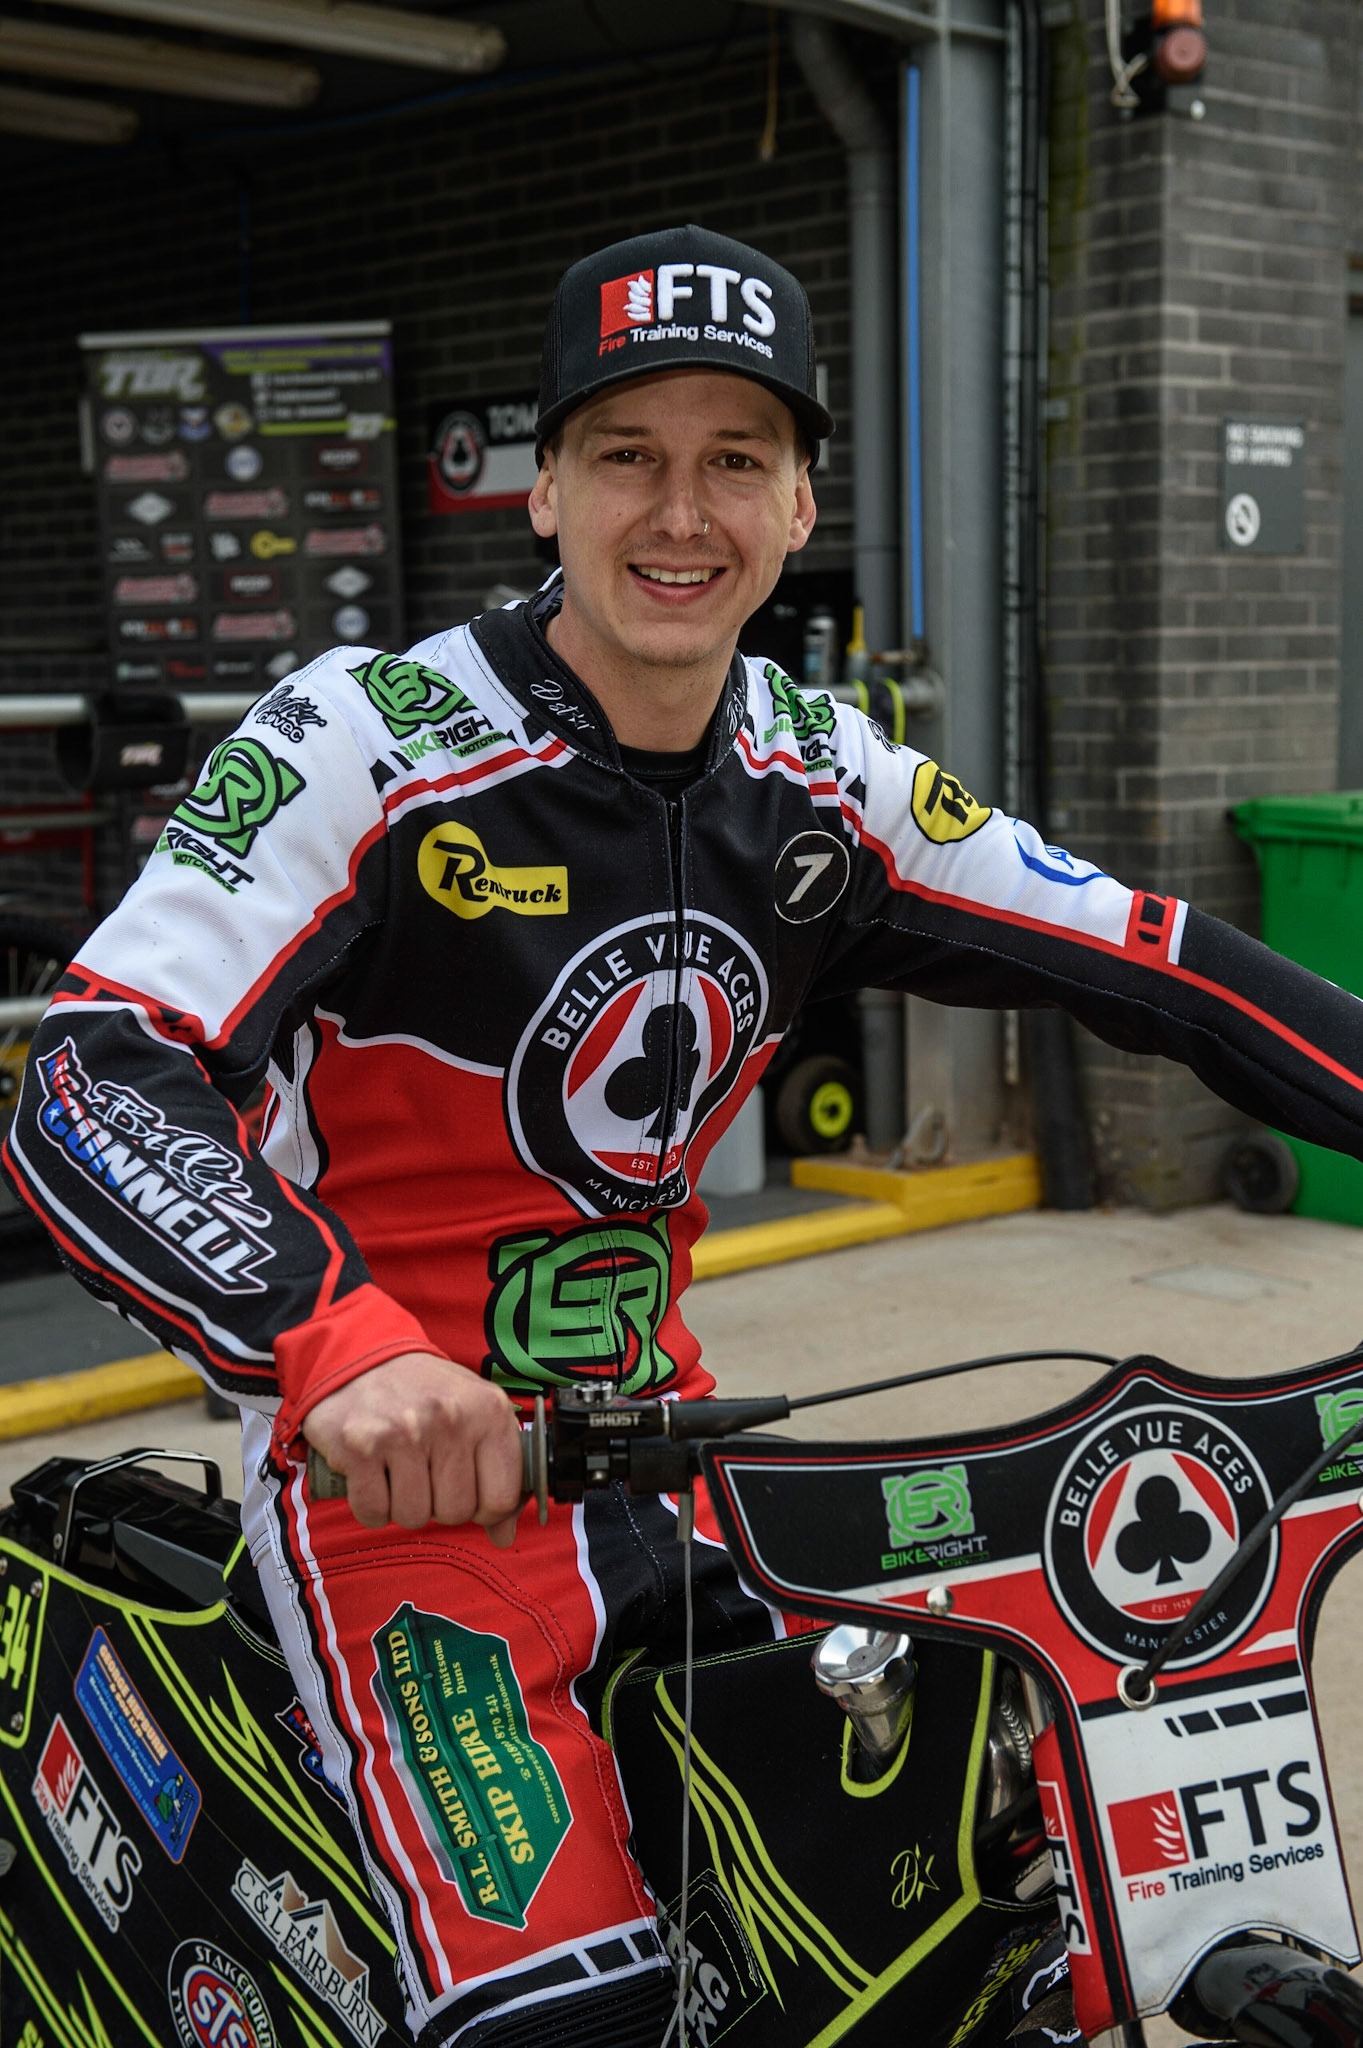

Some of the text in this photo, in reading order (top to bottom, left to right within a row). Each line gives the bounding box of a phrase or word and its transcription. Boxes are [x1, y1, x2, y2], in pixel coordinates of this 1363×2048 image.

[656, 263, 776, 338] FTS
[598, 323, 774, 359] Fire Training Services
[433, 840, 562, 903] Rentruck
[785, 853, 834, 905] 7
[541, 931, 755, 1052] BELLE VUE ACES
[588, 1411, 641, 1428] GHOST
[1060, 1421, 1253, 1528] BELLE VUE ACES
[880, 1535, 988, 1571] BIKERIGHT
[98, 1643, 128, 1694] GEORGE
[125, 1693, 169, 1761] HEPBURN
[433, 1639, 454, 1699] Whitsome
[450, 1661, 467, 1695] Duns
[484, 1693, 500, 1716] 241
[491, 1717, 506, 1741] 870
[388, 1630, 500, 1906] R.L. SMITH & SONS LTD
[452, 1708, 535, 1865] SKIP HIRE
[66, 1770, 141, 1911] FTS
[1179, 1760, 1321, 1860] FTS
[33, 1776, 119, 1930] Fire Training Services
[1126, 1843, 1324, 1902] Fire Training Services
[1049, 1841, 1086, 1945] FTS
[237, 1870, 382, 2045] C & L FAIRBURN
[278, 1942, 329, 1998] PROPERTIES
[195, 1945, 273, 2048] STAKEFORD
